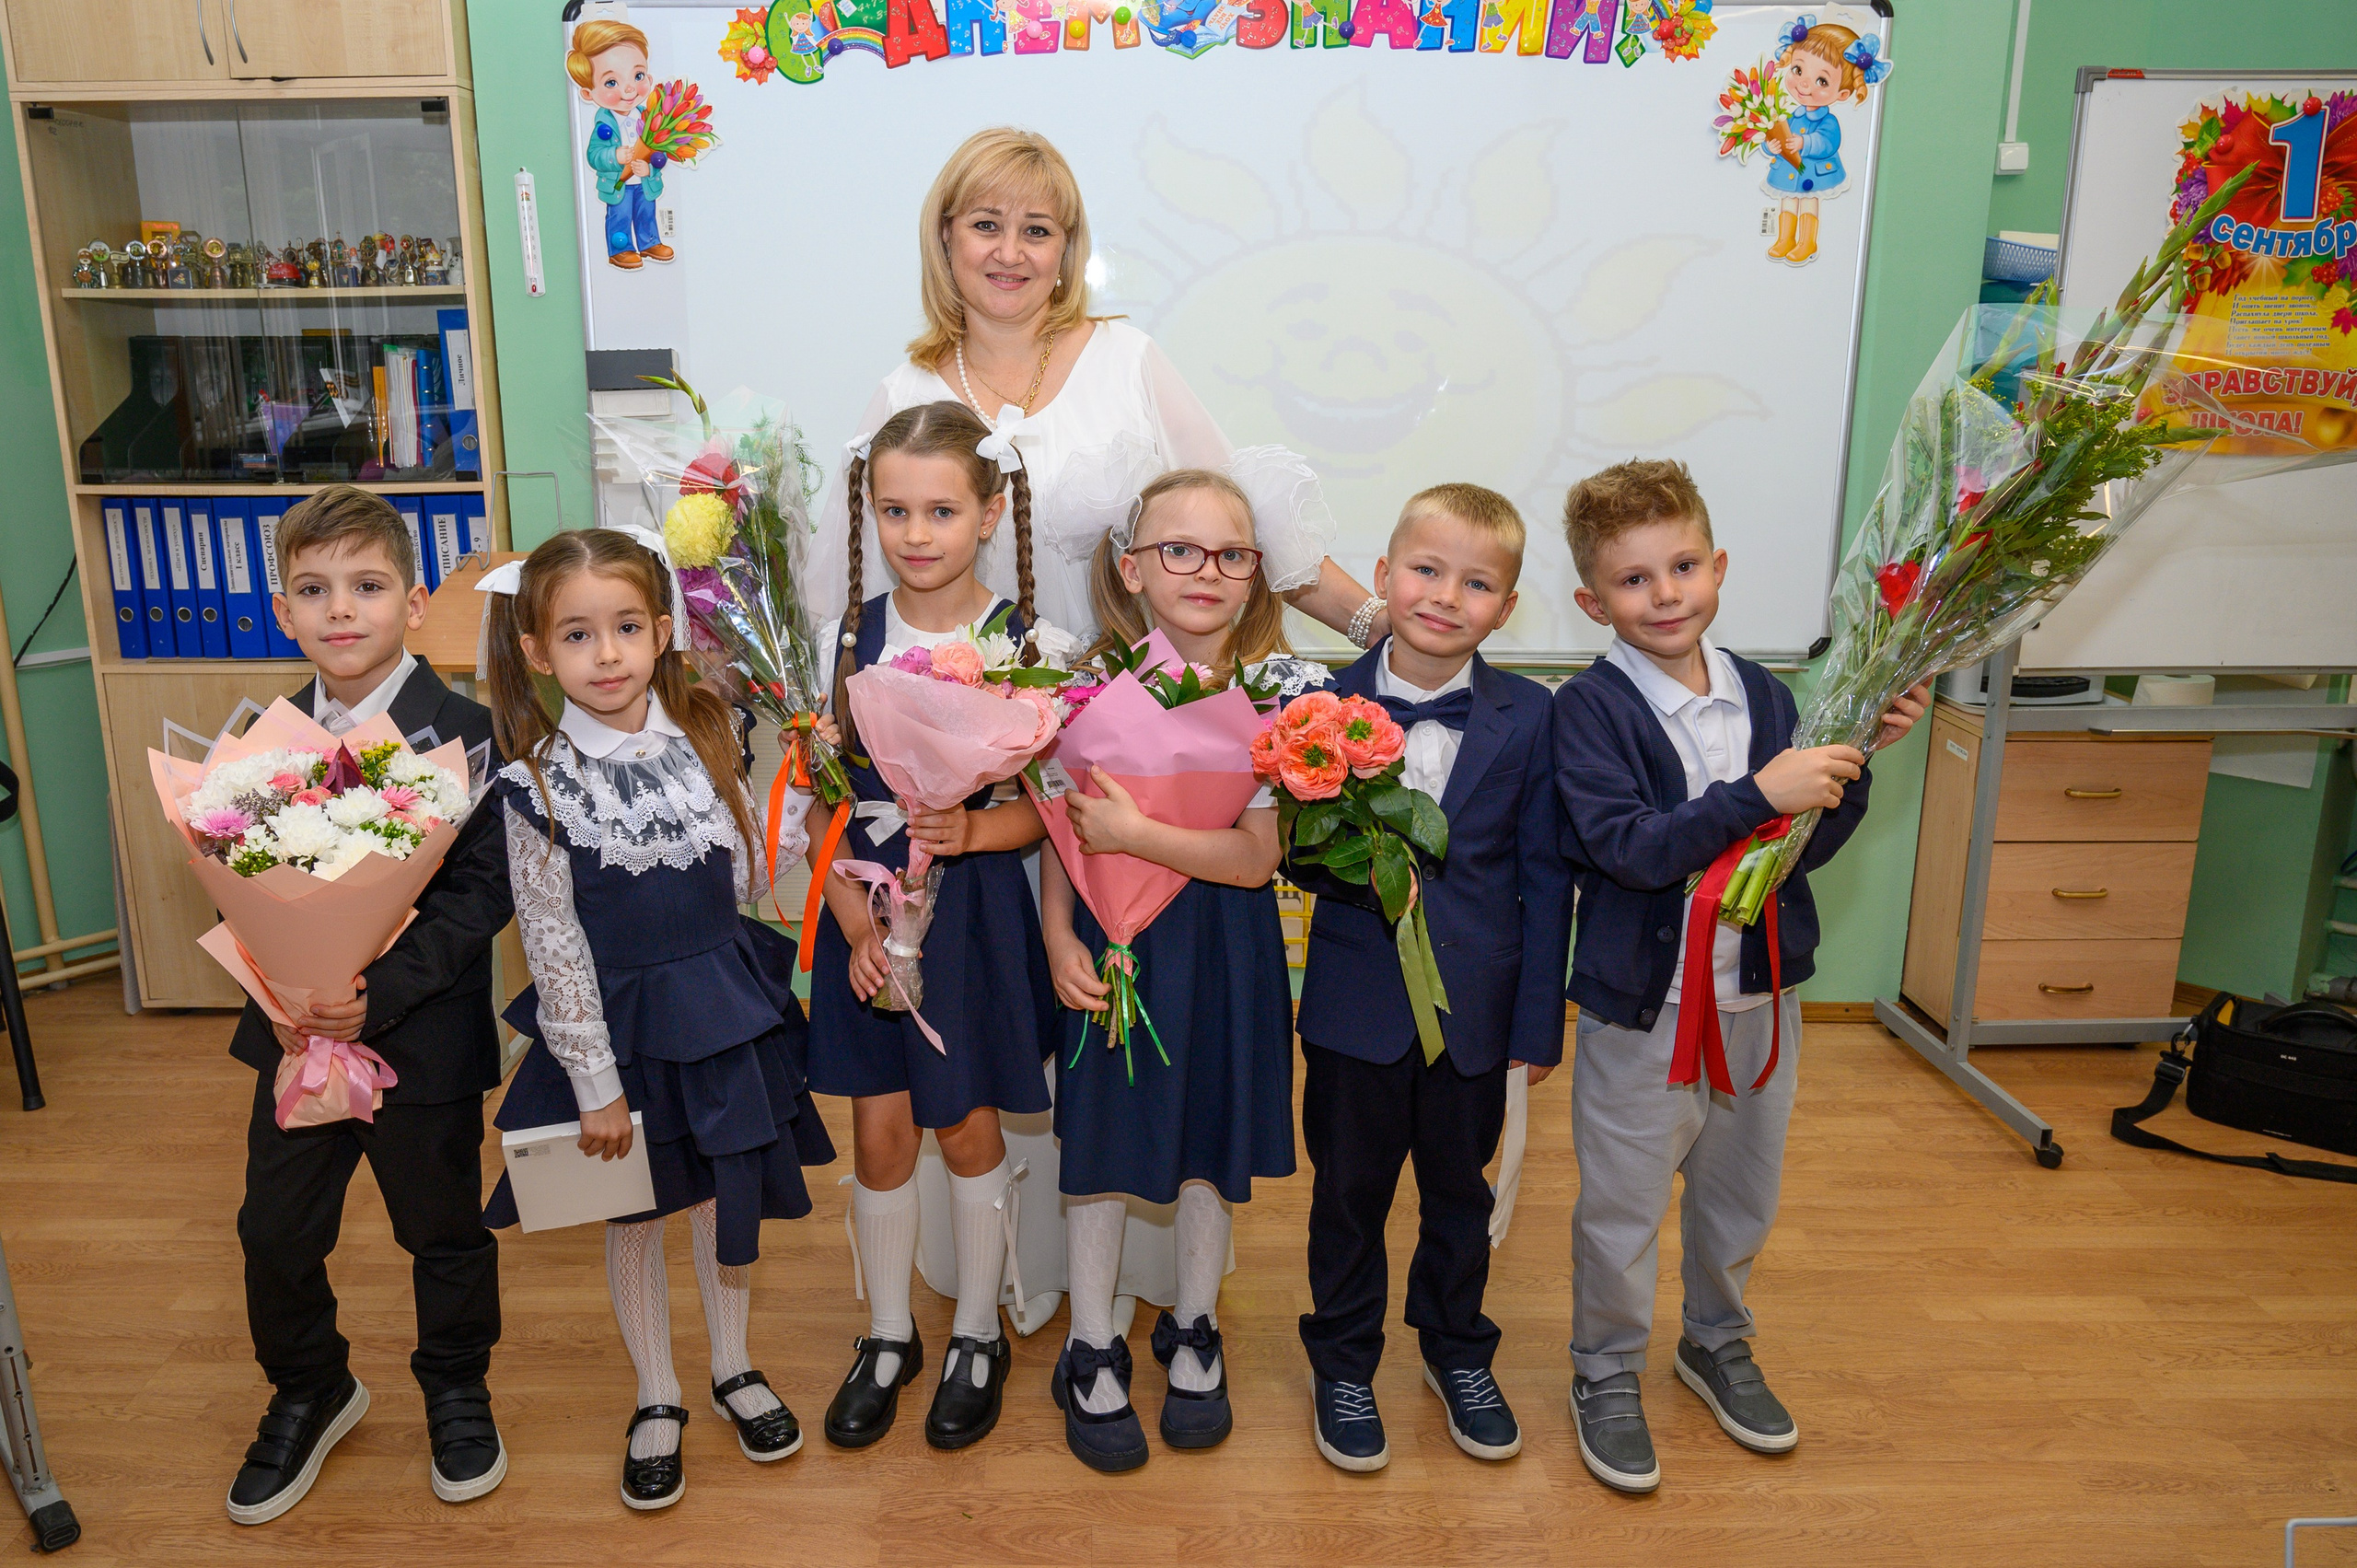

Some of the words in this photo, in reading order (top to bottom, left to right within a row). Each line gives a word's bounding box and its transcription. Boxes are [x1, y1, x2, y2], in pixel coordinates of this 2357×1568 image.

[765, 0, 825, 85] С
[881, 0, 1142, 69] ДНЕМ
[2269, 105, 2330, 223] 1
[2211, 214, 2357, 259] сентябр
[2231, 309, 2270, 318] Распахнула
[2249, 294, 2278, 302] учебный
[457, 354, 466, 386] Личное
[143, 517, 152, 555] БЕЗОПАСНОСТИ
[198, 531, 207, 572] Сценарии
[234, 541, 242, 564] класс
[262, 524, 278, 586] ПРОФСОЮЗ
[412, 529, 424, 571] руководство
